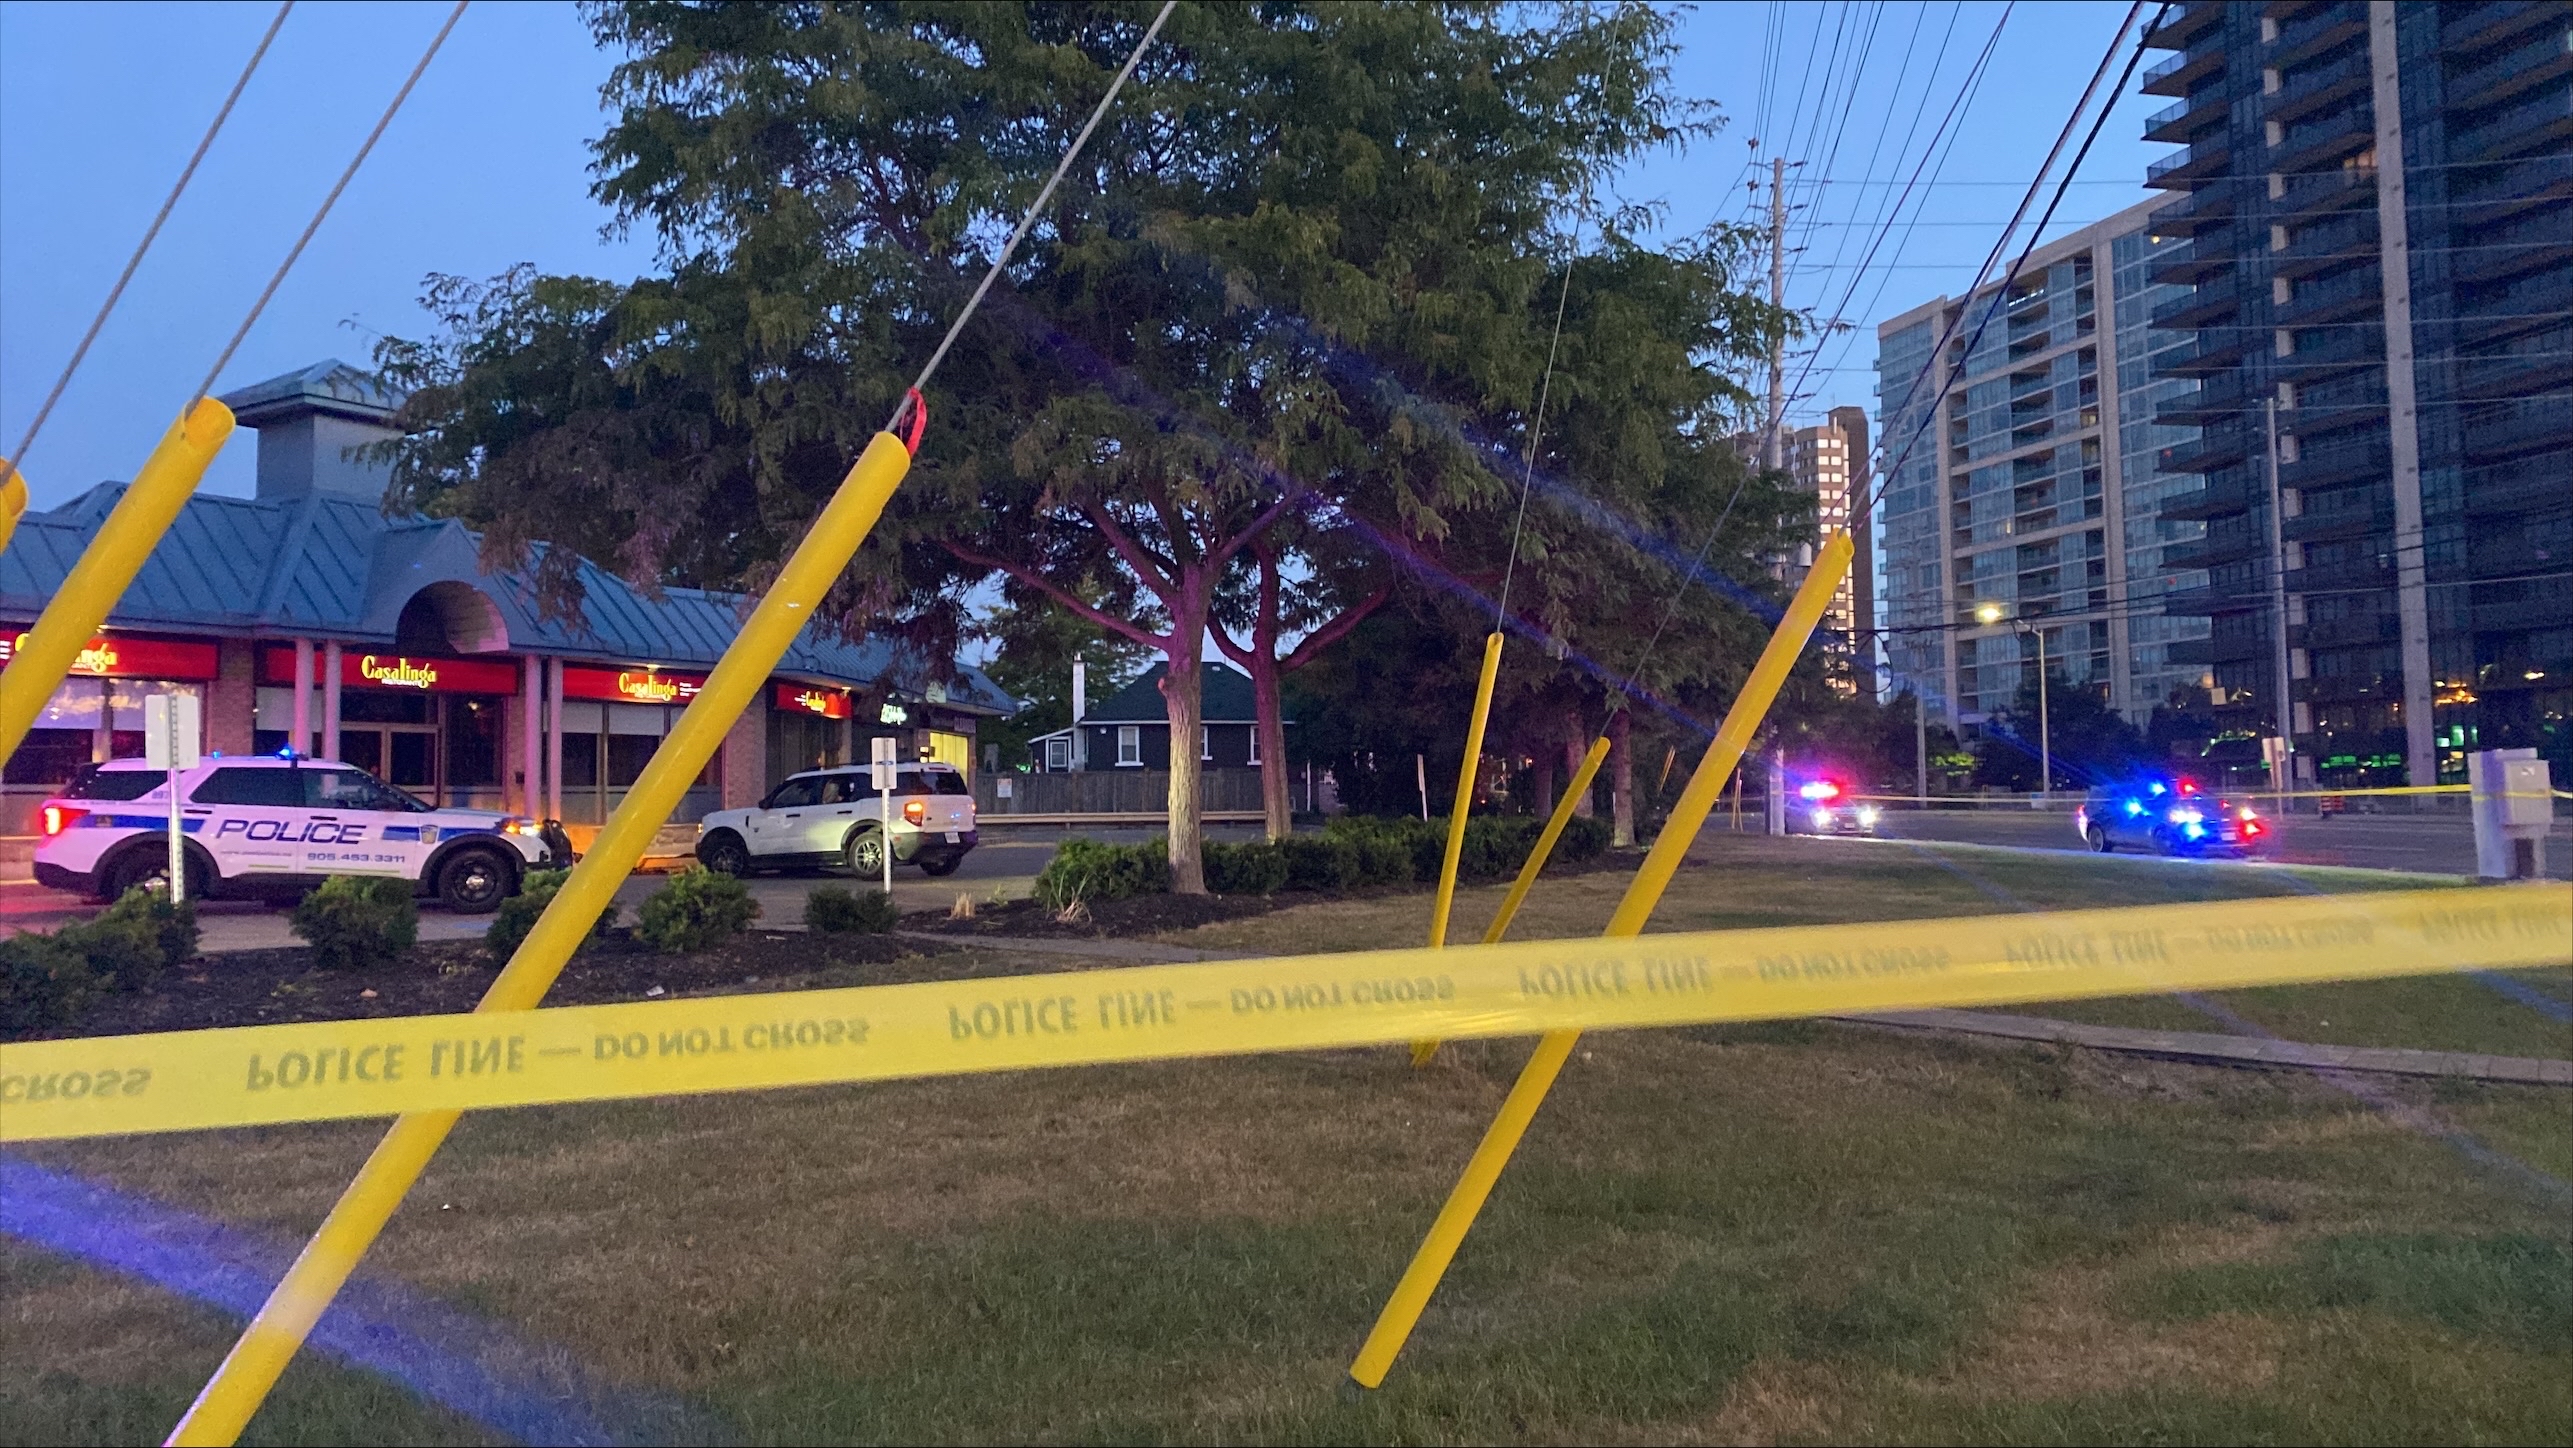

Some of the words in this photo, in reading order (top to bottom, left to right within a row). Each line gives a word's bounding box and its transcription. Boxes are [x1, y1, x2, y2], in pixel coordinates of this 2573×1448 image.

[361, 655, 437, 689] Casalinga
[216, 819, 367, 845] POLICE
[307, 852, 406, 864] 905.453.3311
